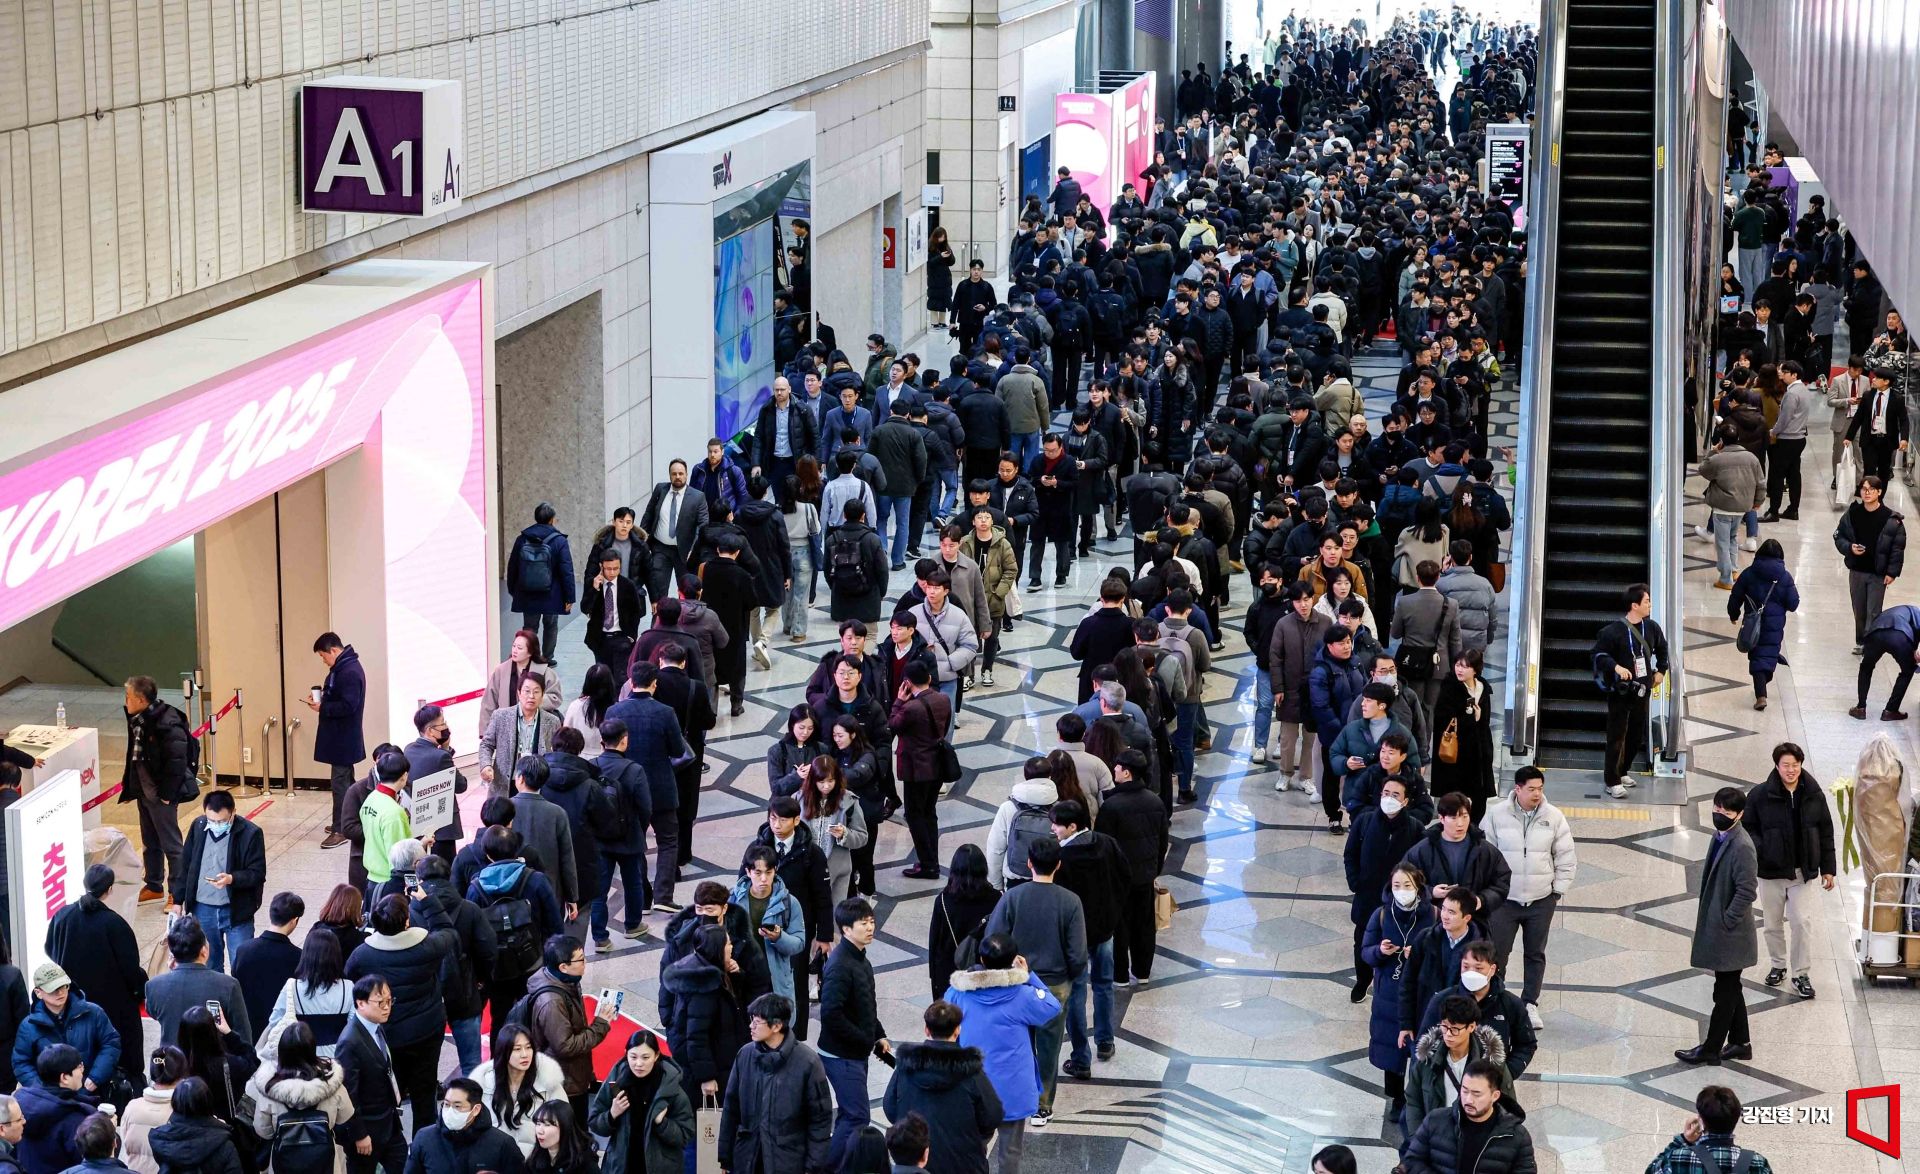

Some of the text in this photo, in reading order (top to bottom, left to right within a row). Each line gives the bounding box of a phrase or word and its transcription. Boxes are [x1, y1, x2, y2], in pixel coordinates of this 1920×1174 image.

[314, 107, 413, 197] A1
[443, 147, 460, 202] A1
[188, 357, 357, 489] 2025
[417, 780, 452, 798] REGISTER NOW
